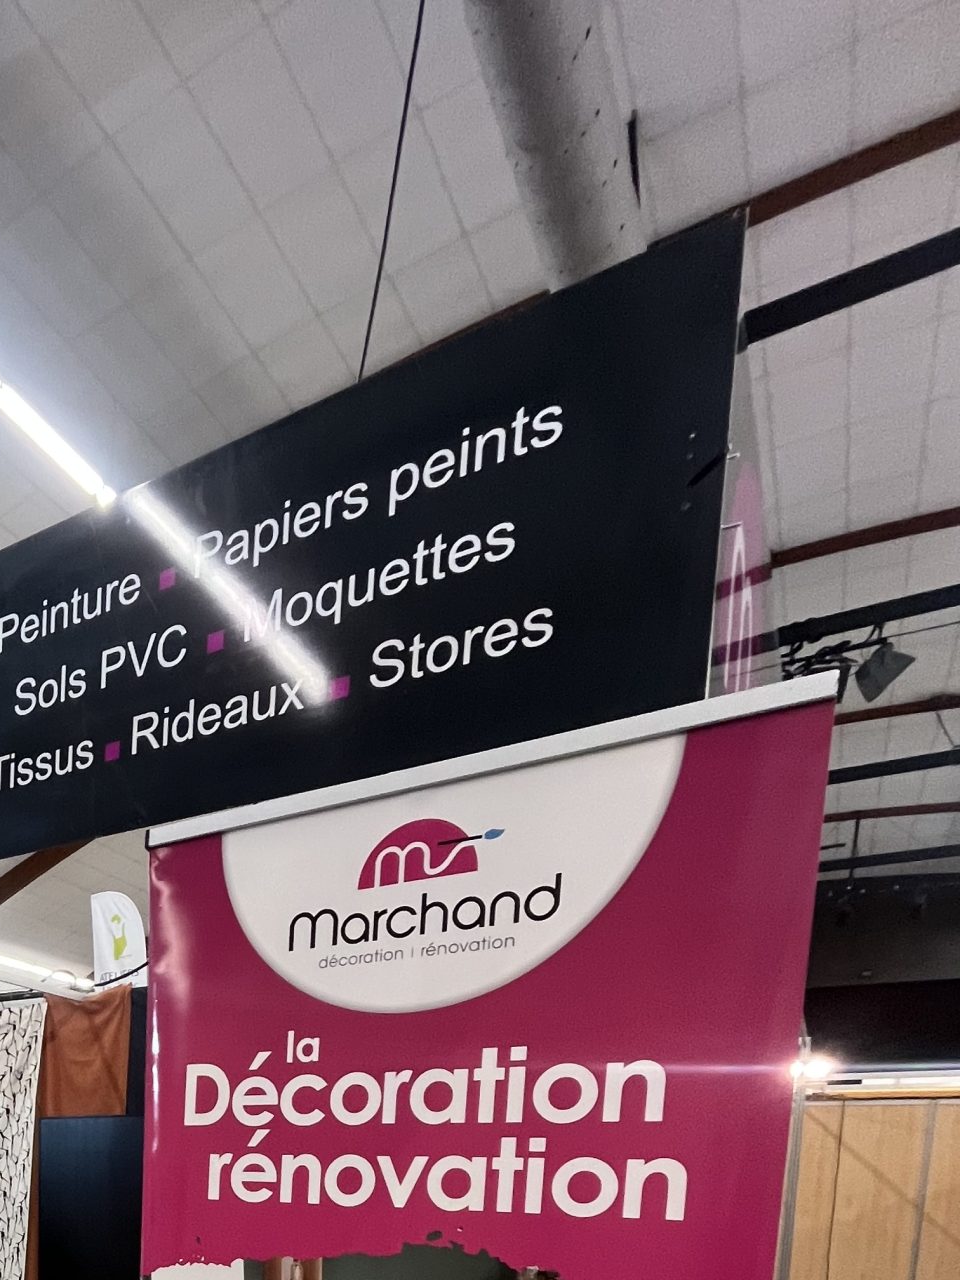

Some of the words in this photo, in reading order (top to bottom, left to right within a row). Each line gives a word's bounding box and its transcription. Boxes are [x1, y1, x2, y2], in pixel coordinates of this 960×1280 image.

[193, 482, 369, 578] Papiers
[389, 405, 563, 515] peints
[14, 665, 86, 716] Sols
[100, 624, 187, 689] PVC
[243, 522, 516, 642] Moquettes
[131, 678, 305, 755] Rideaux
[370, 607, 554, 689] Stores
[318, 948, 404, 969] décoration
[421, 935, 515, 958] rénovation
[184, 1045, 666, 1127] Décoration
[286, 1031, 321, 1063] la
[207, 1129, 688, 1221] rénovation
